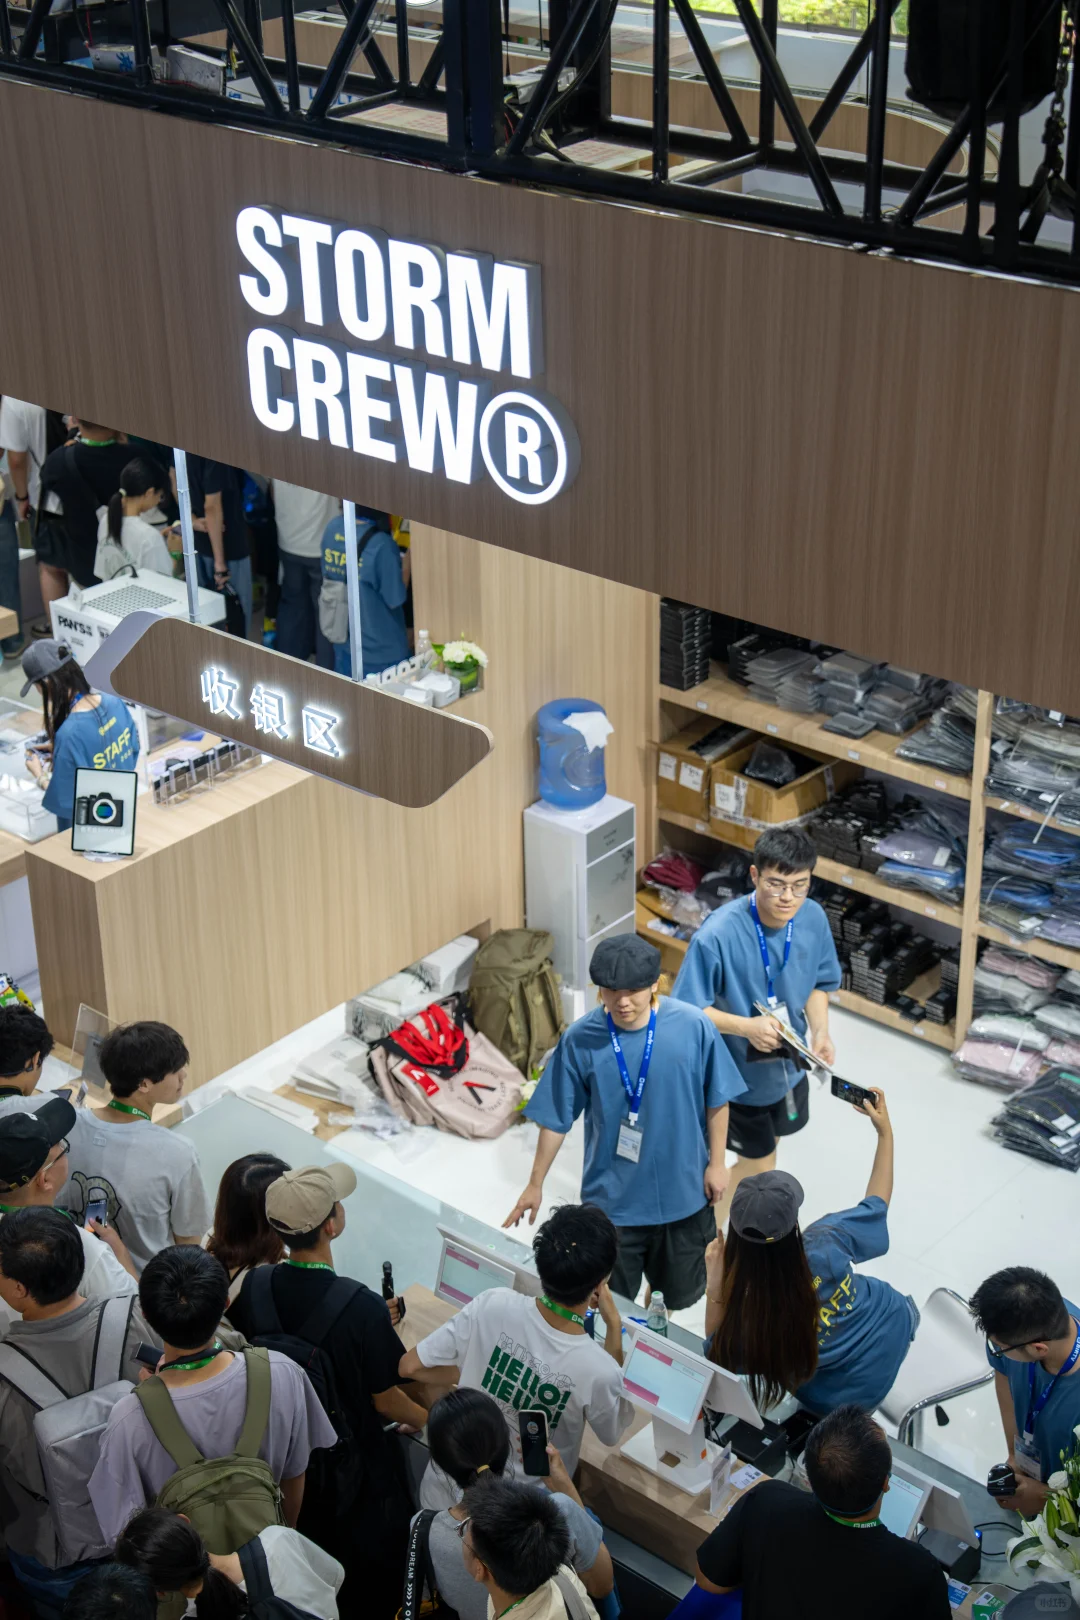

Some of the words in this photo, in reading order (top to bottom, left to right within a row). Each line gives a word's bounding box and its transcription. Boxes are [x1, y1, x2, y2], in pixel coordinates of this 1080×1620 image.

[236, 206, 531, 379] STORM
[93, 727, 131, 769] STAFF
[200, 667, 340, 758] 收银区
[489, 1345, 571, 1410] HELLO!
